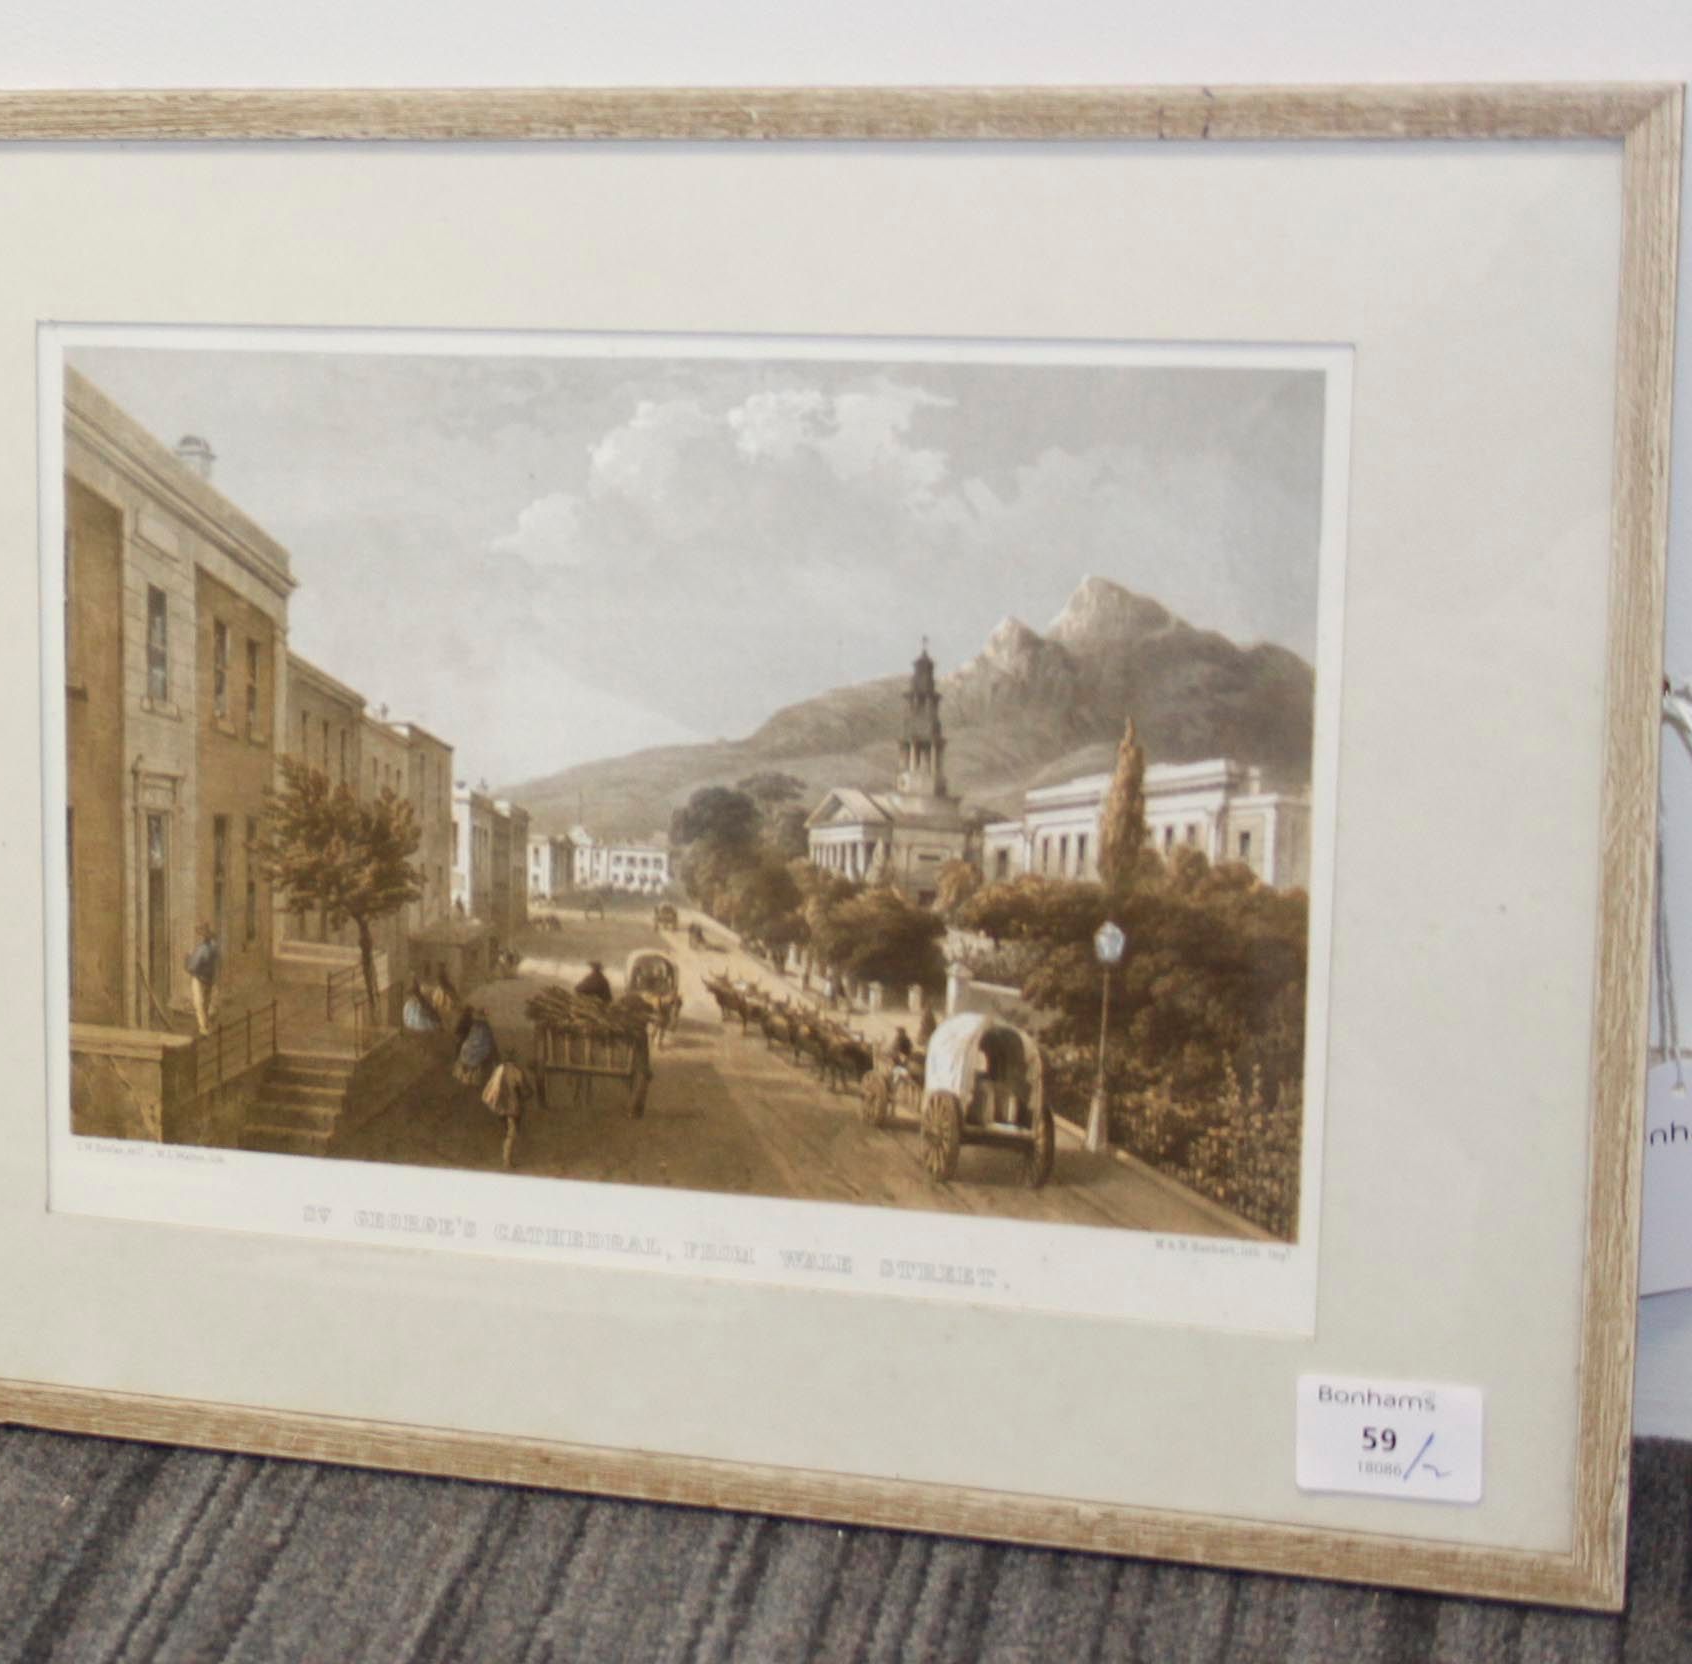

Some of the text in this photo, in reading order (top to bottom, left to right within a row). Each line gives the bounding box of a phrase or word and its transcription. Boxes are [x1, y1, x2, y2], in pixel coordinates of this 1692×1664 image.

[683, 1240, 756, 1266] FROM
[779, 1249, 854, 1276] WALE
[1317, 1384, 1436, 1413] Bonhams
[1361, 1426, 1398, 1453] 59
[1358, 1460, 1403, 1477] 18086
